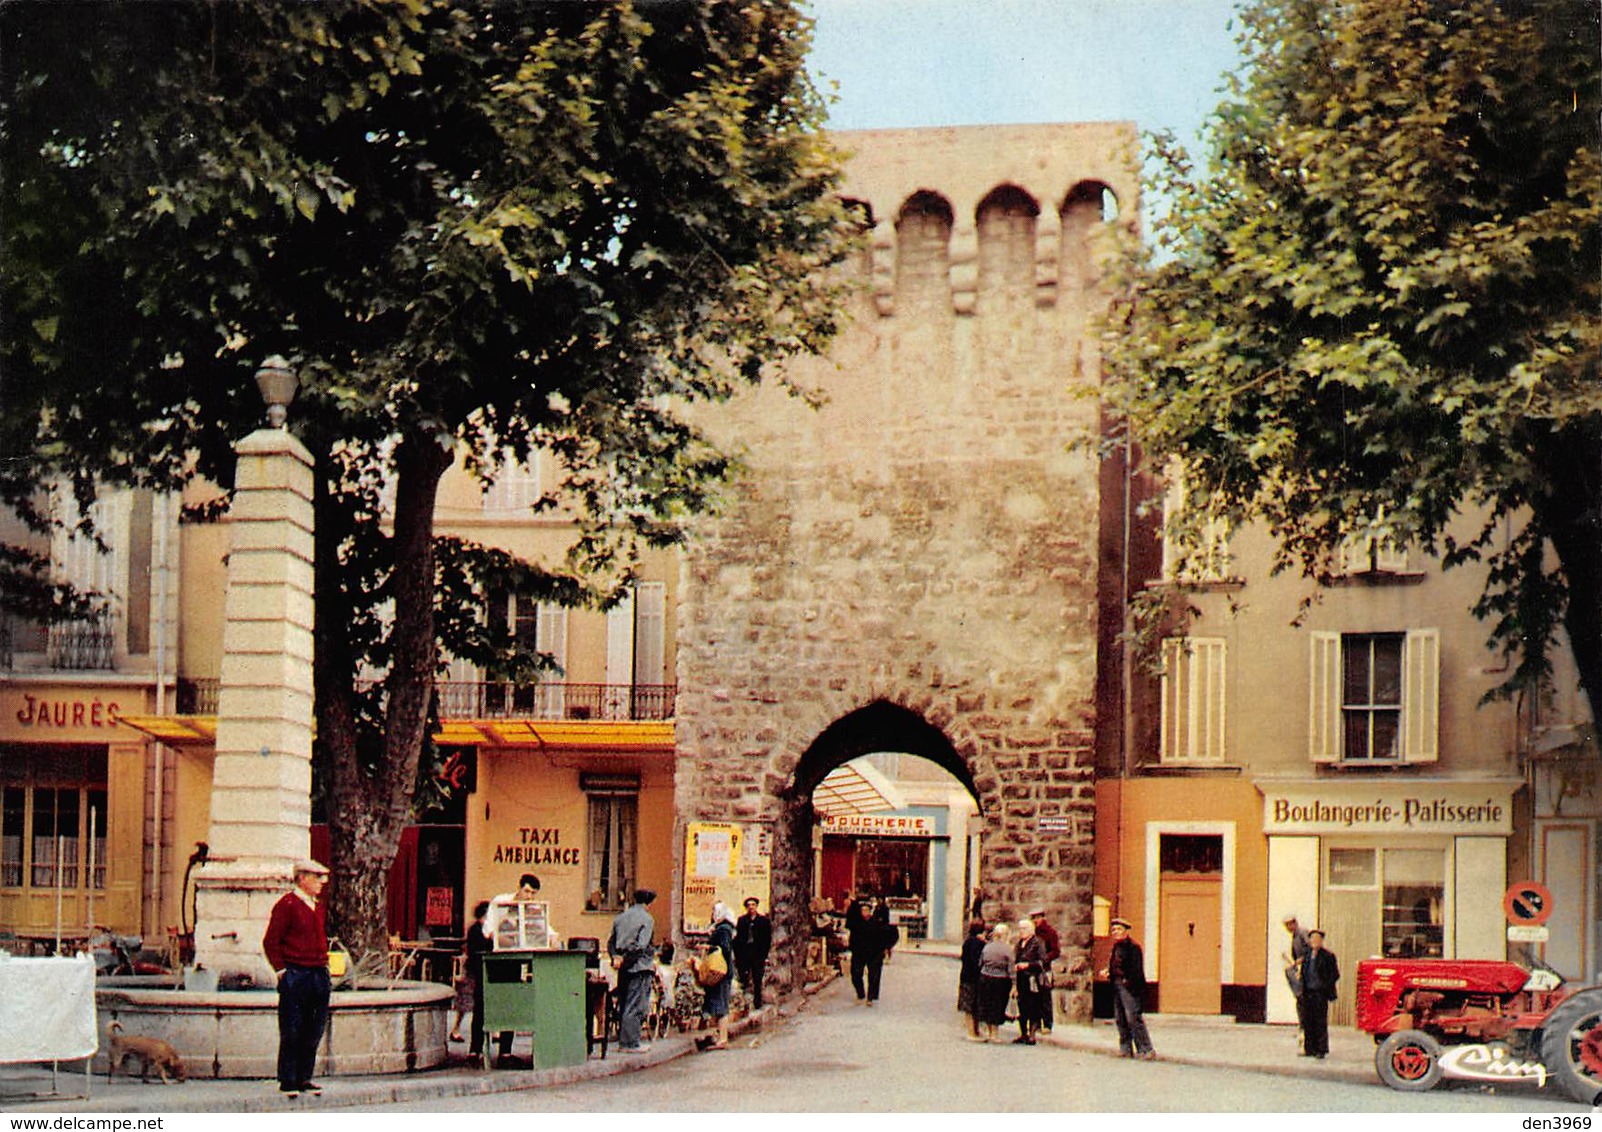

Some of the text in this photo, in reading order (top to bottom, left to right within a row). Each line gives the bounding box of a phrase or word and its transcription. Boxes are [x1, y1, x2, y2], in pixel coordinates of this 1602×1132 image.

[826, 816, 924, 828] BOUCHERIE
[519, 828, 559, 845] TAXI
[493, 845, 580, 865] AMBULANCE
